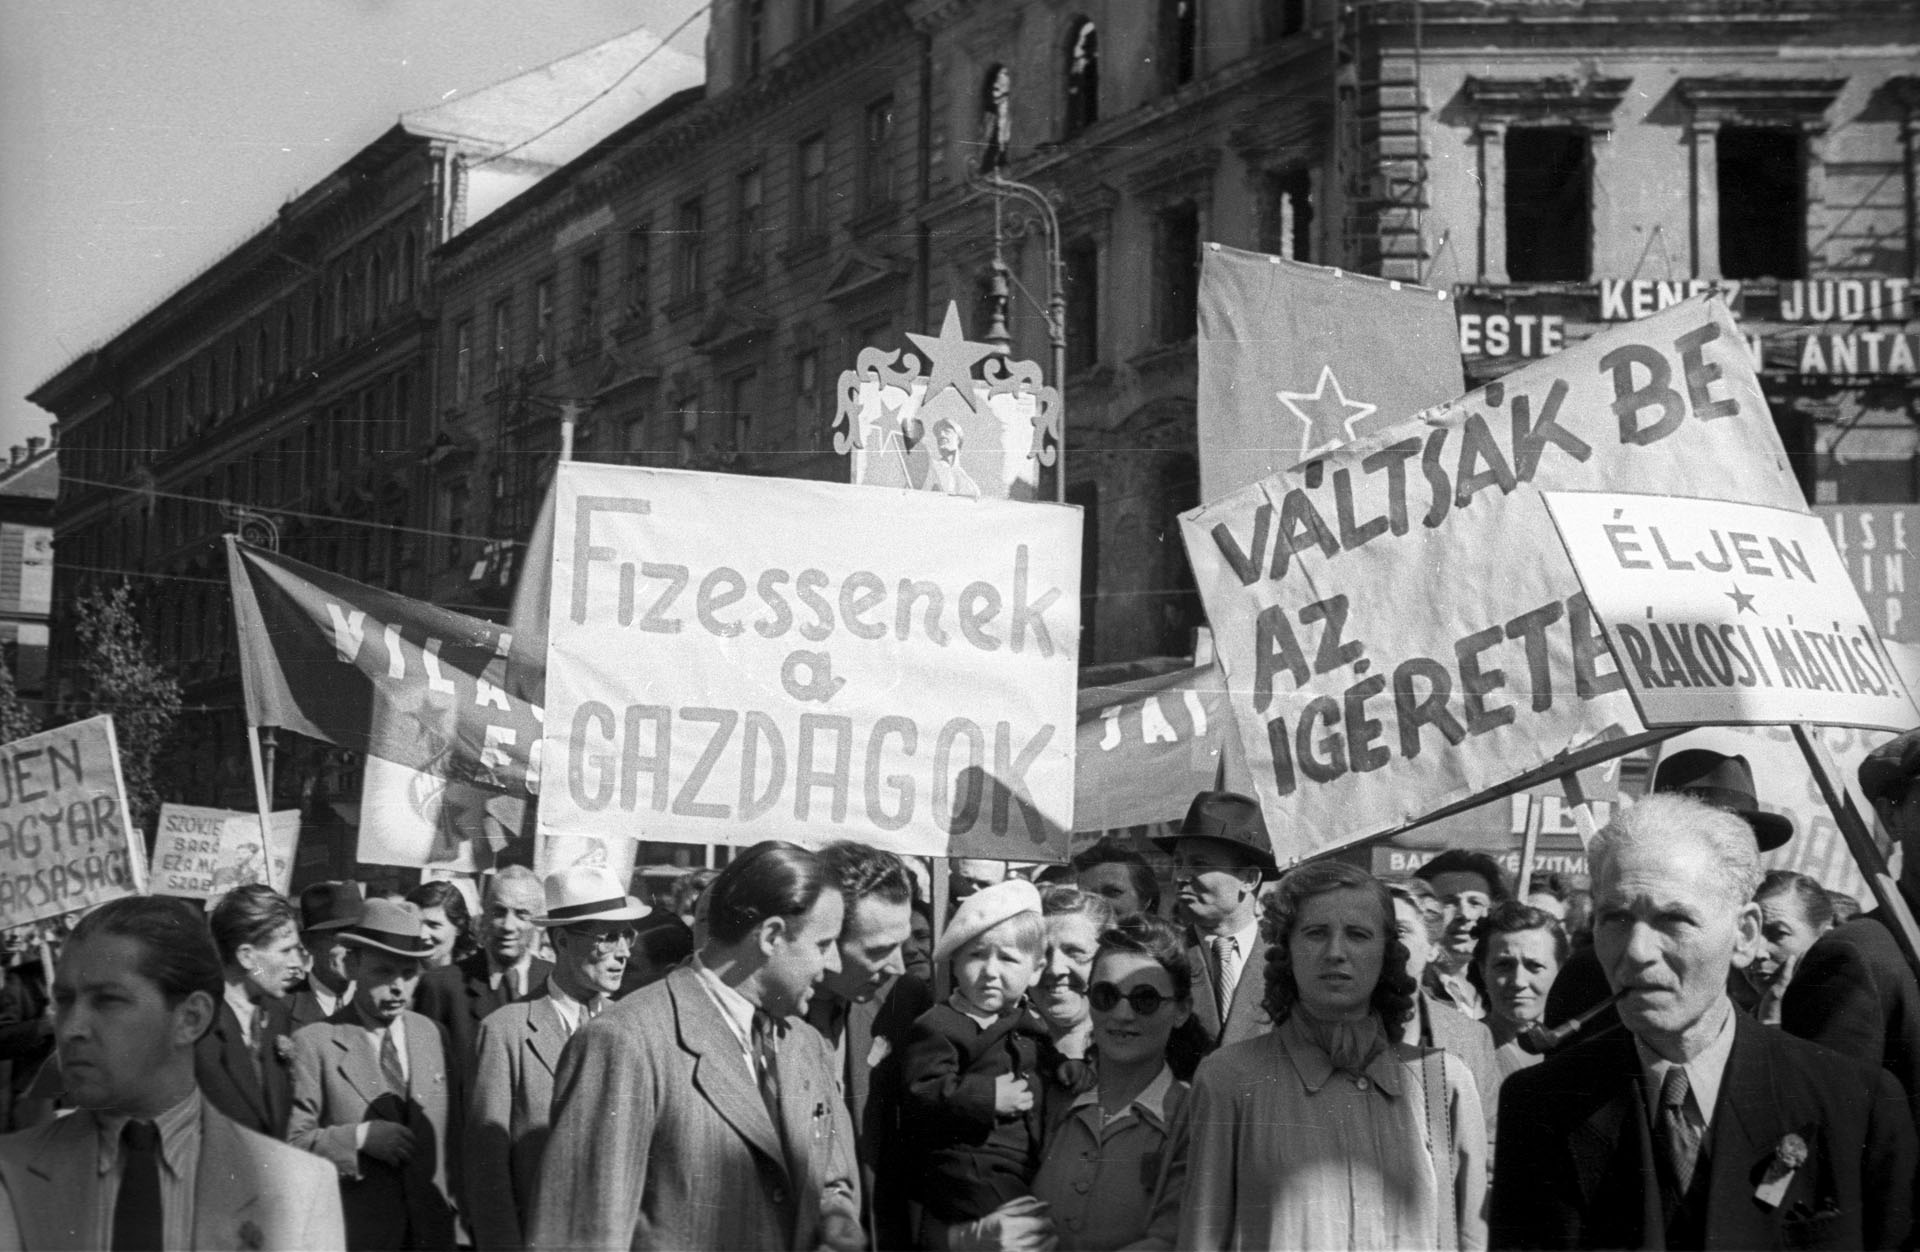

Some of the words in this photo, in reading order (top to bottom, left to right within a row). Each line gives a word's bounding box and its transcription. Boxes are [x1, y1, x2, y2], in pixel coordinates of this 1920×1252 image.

[1460, 314, 1562, 356] ESTE
[1781, 278, 1909, 320] JUDIT
[1210, 377, 1593, 586] VÁLTSÁK
[1599, 321, 1741, 446] BE
[570, 494, 1062, 657] Fizessenek
[1603, 508, 1817, 583] ÉLJEN
[780, 648, 846, 704] a
[1253, 594, 1364, 714] AZ
[1615, 606, 1773, 689] RÁKOSI
[1762, 614, 1901, 698] MÁTYÁS!
[568, 700, 1056, 845] GAZDAGOK
